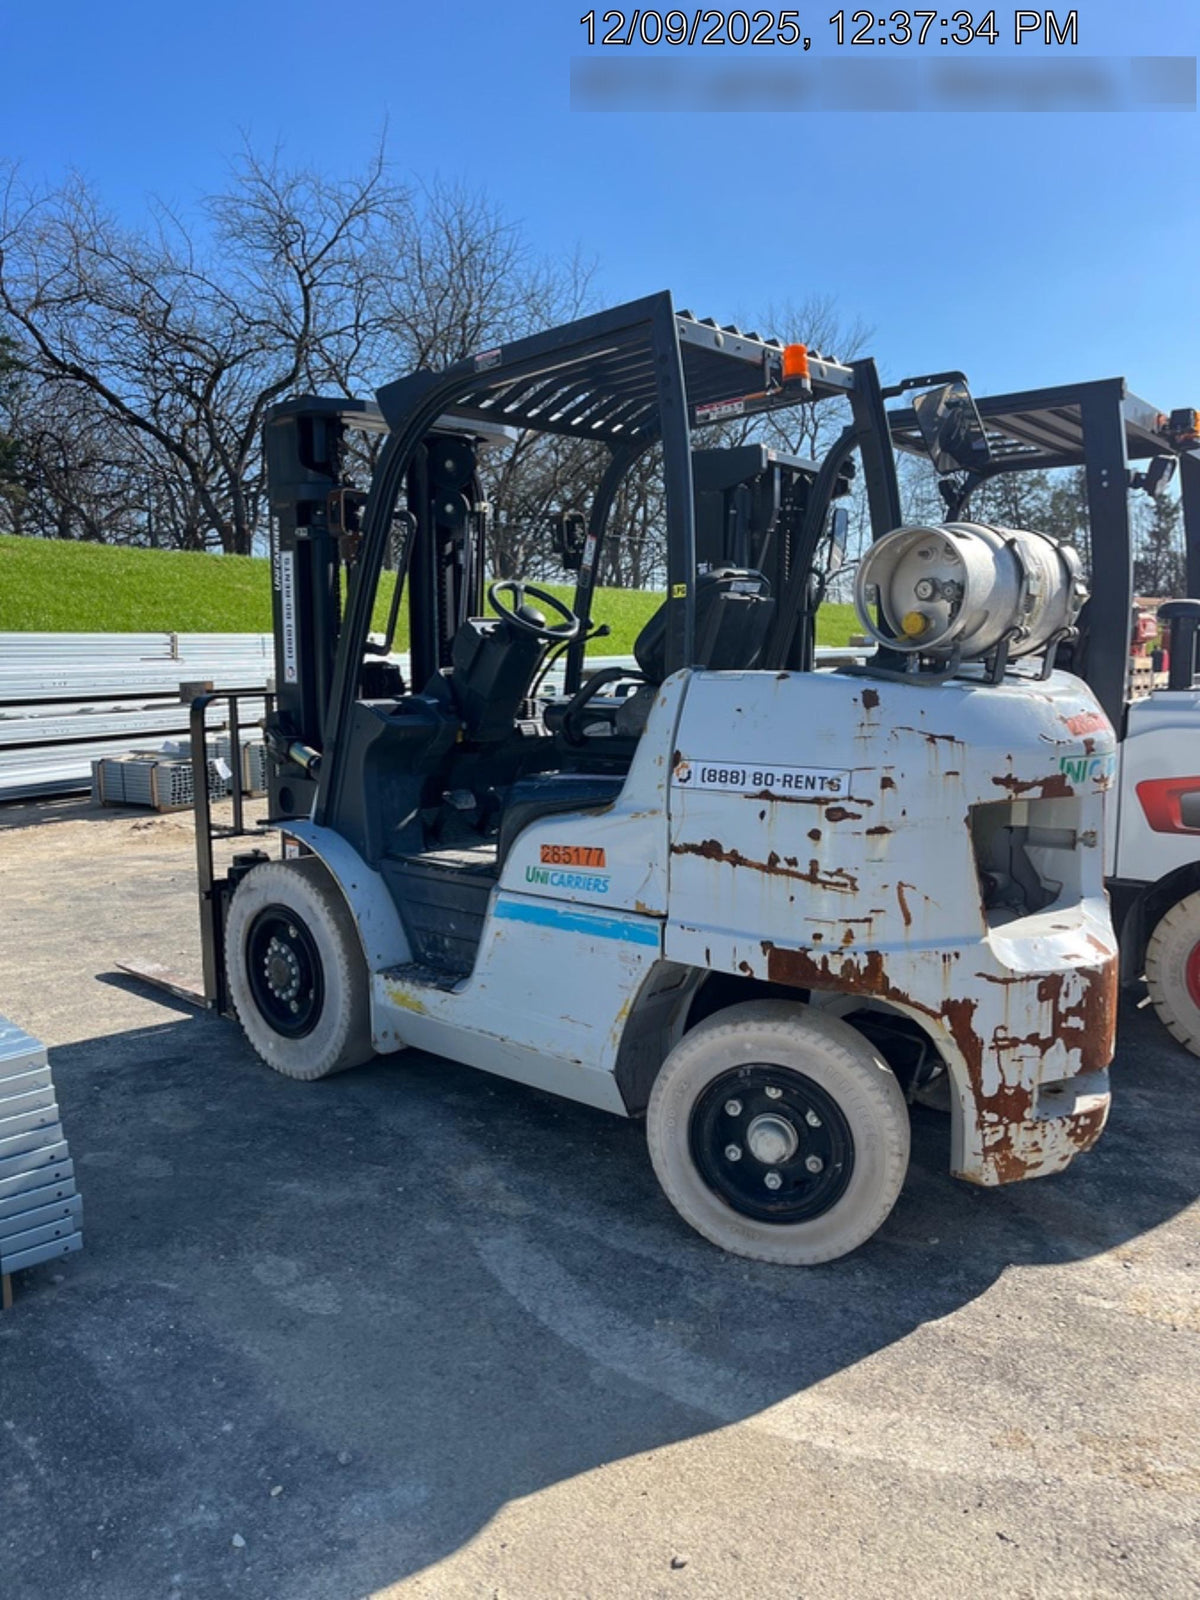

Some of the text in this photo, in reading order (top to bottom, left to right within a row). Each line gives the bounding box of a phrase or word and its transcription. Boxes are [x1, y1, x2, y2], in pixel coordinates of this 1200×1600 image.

[701, 767, 842, 792] (888) 80-RENTS
[541, 844, 605, 867] 265177
